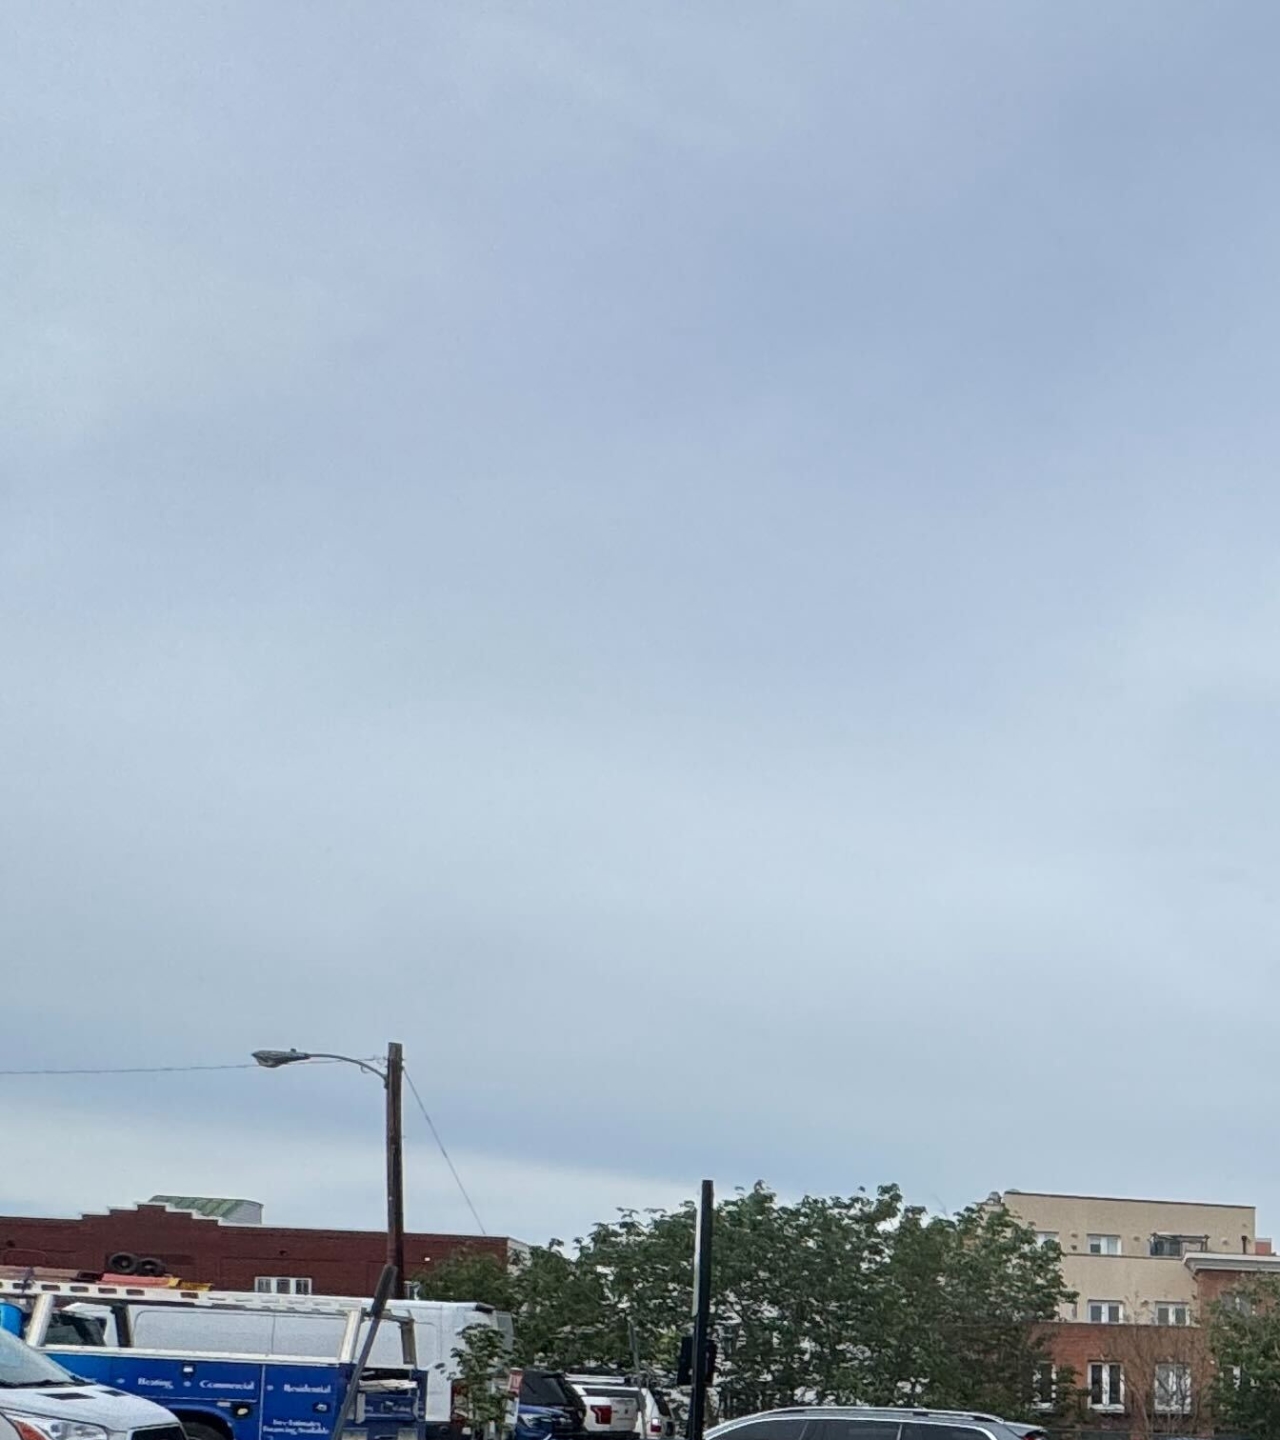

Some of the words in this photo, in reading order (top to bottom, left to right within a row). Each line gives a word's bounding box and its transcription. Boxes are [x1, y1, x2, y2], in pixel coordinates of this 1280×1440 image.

[138, 1377, 174, 1390] Heating
[199, 1380, 255, 1390] Commercial
[284, 1383, 331, 1393] Residential
